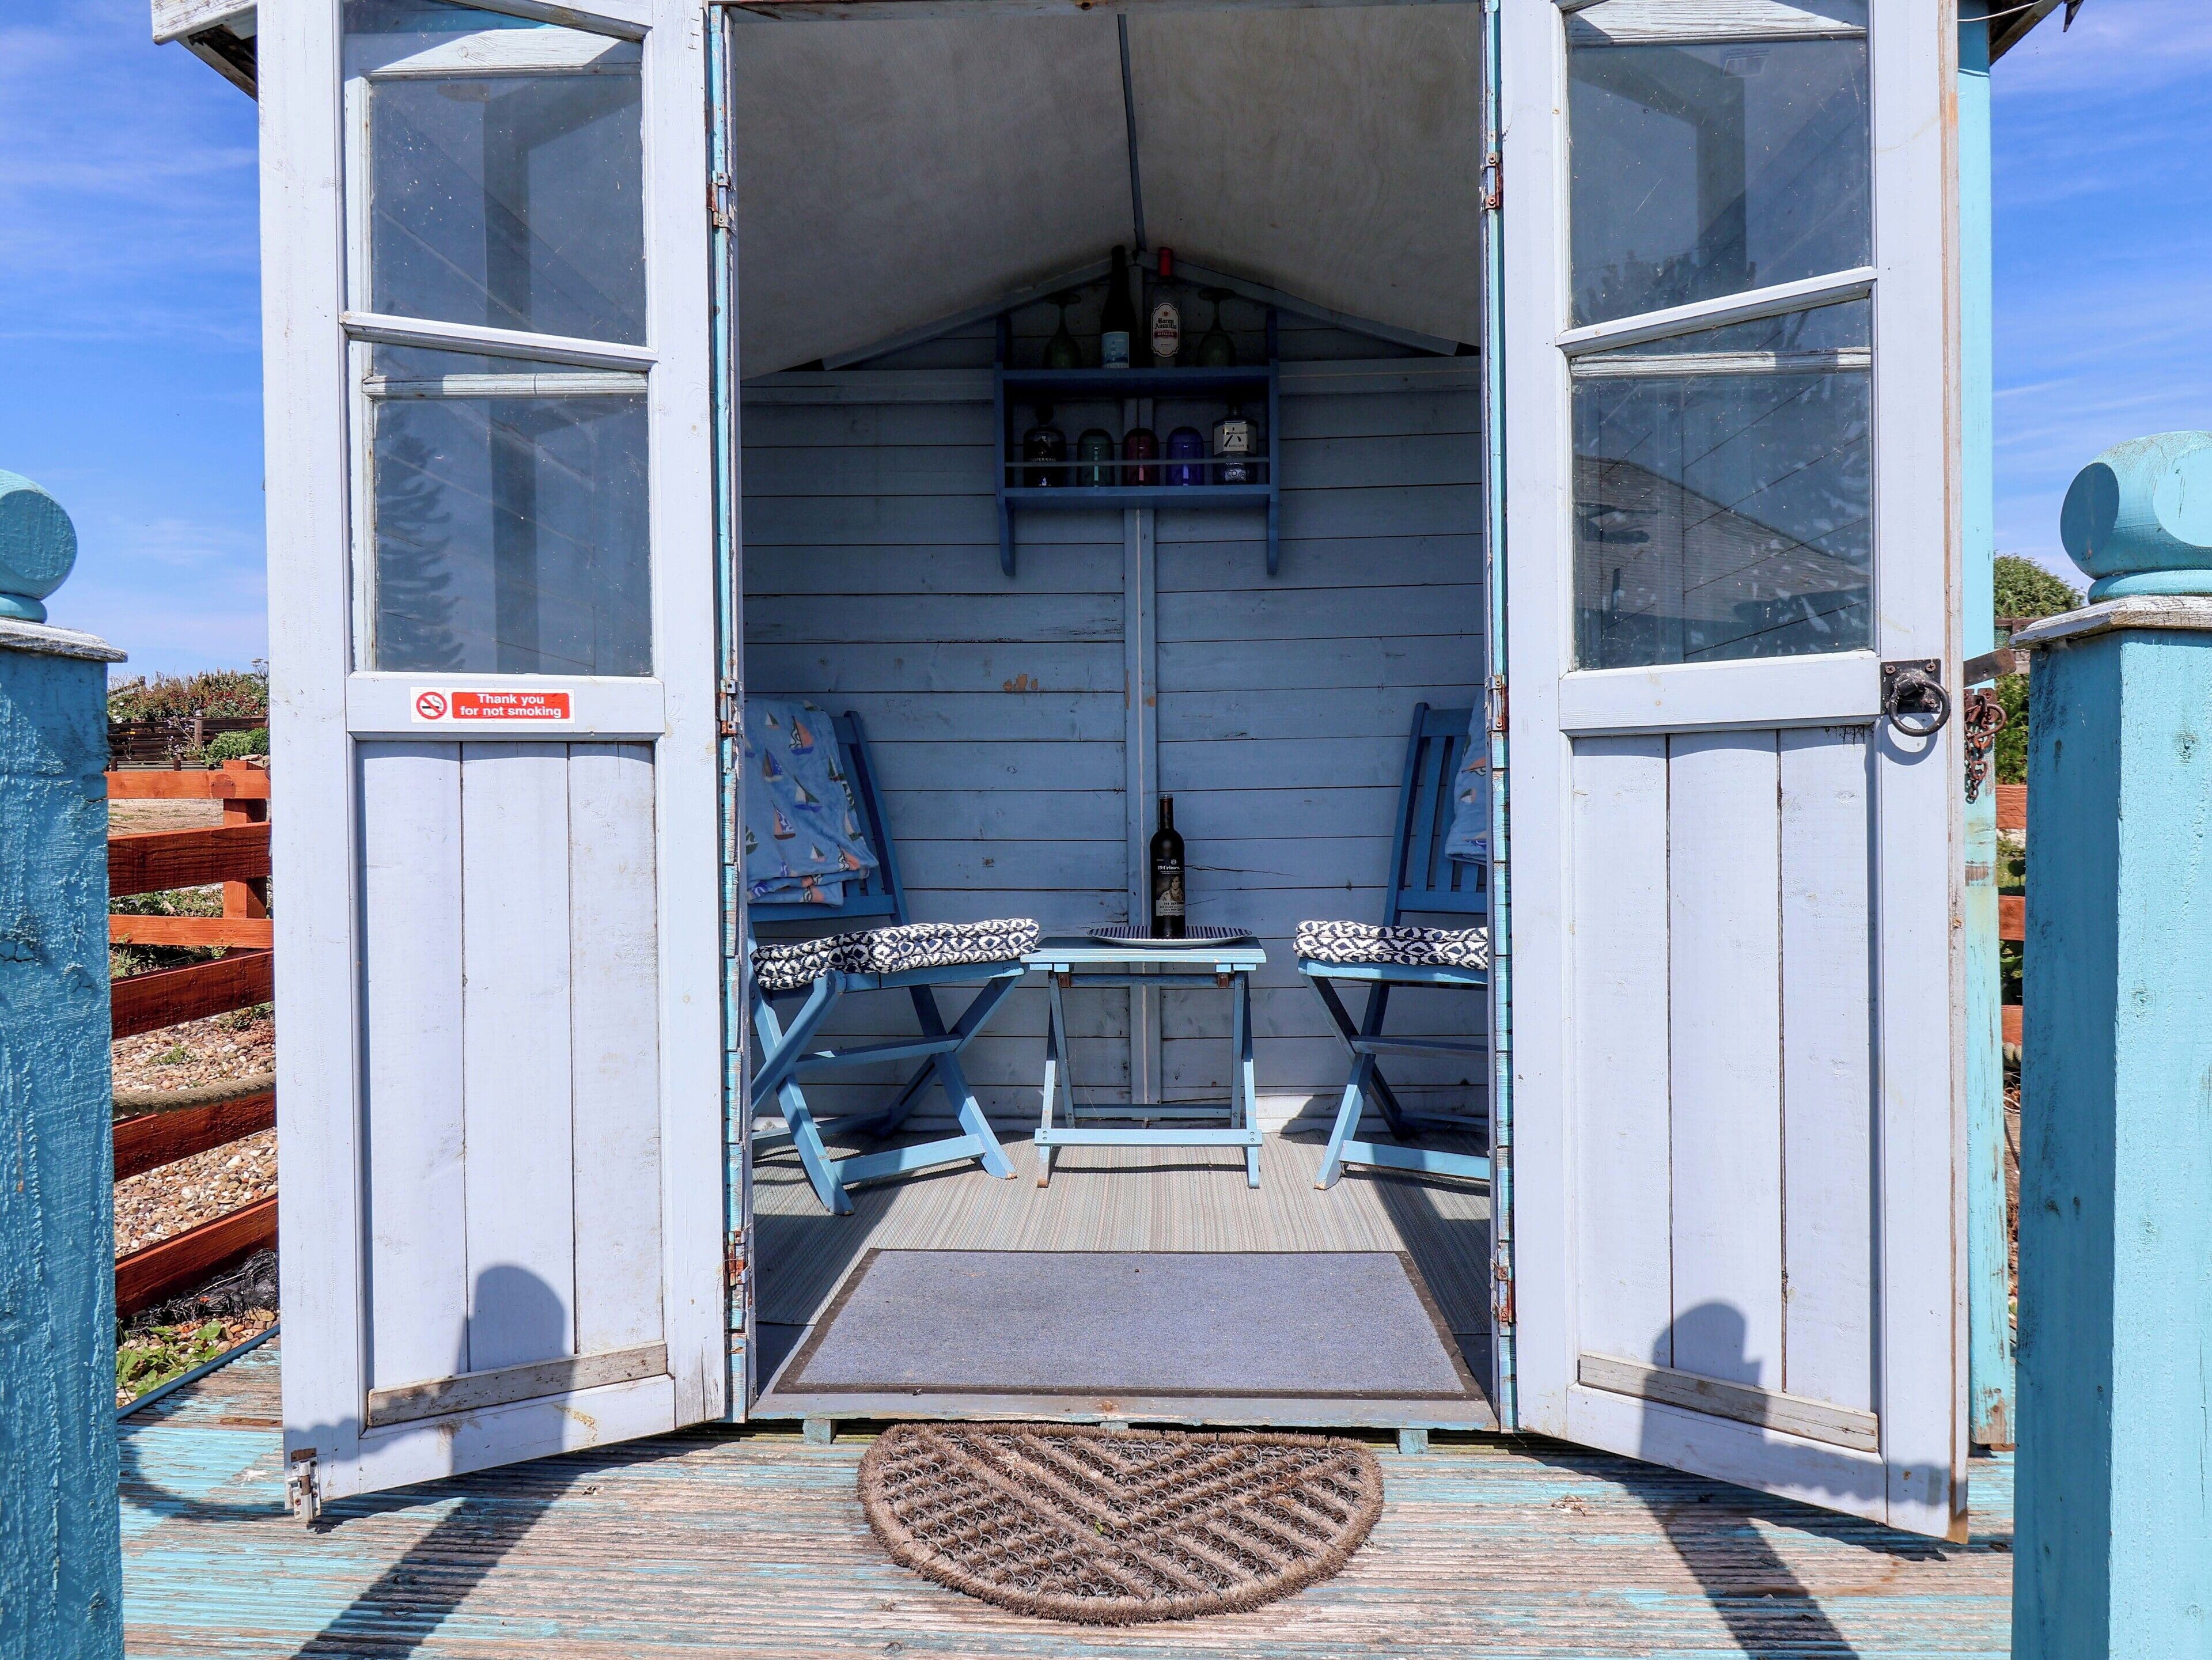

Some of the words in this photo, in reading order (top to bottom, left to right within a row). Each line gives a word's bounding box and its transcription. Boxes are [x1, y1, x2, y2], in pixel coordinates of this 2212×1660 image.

[477, 693, 517, 704] Thank
[521, 695, 544, 706] you
[460, 706, 479, 715] for
[483, 706, 504, 715] not
[507, 706, 562, 718] smoking
